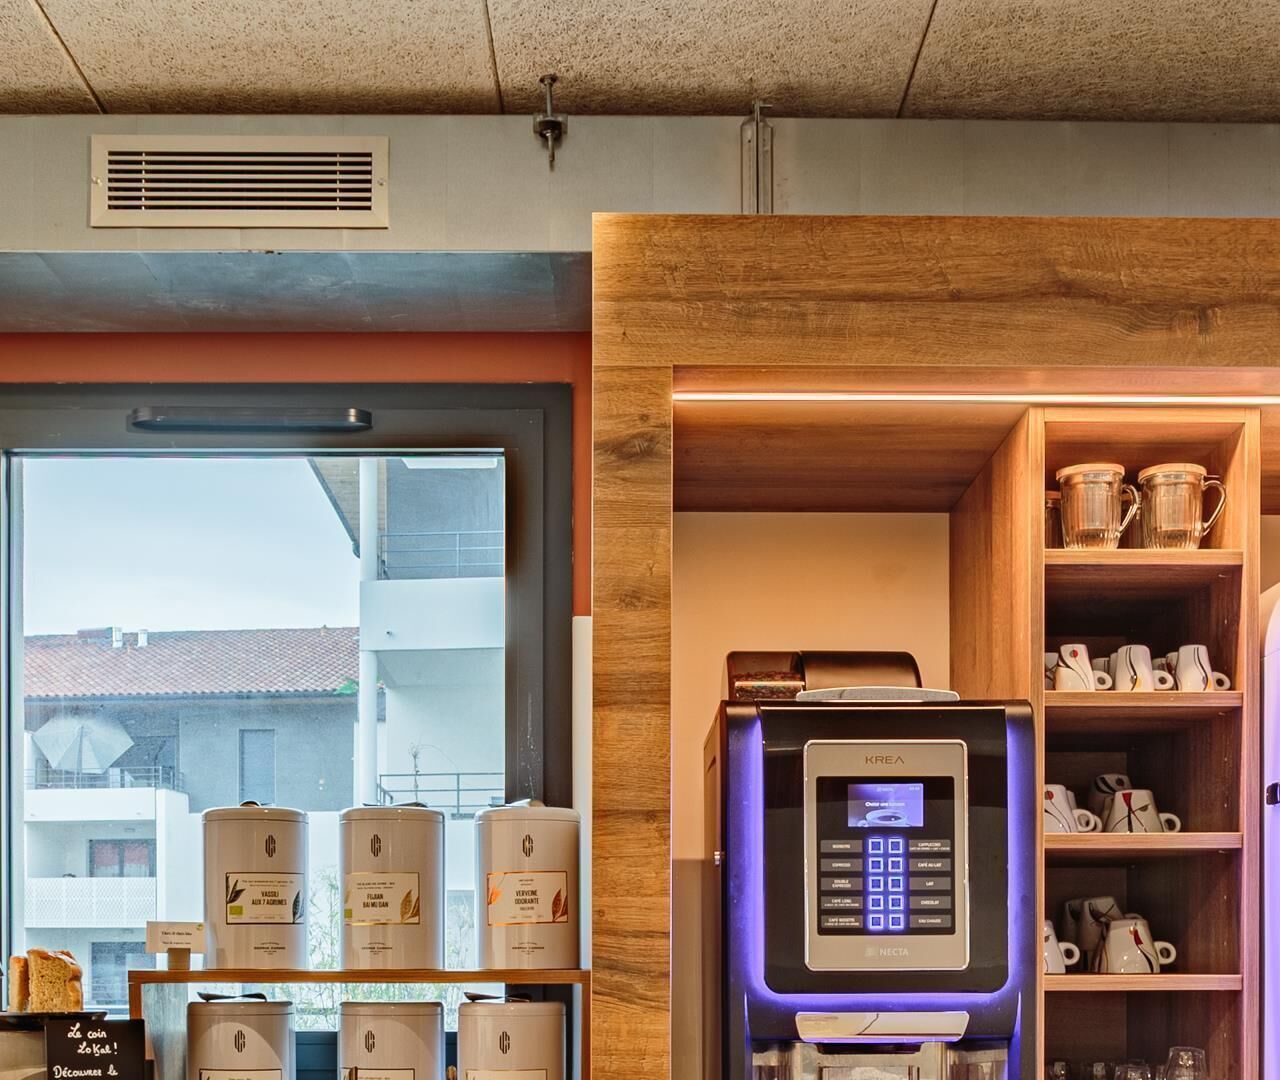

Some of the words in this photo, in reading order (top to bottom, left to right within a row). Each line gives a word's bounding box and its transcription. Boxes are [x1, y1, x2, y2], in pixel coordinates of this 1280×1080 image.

[865, 755, 905, 765] KREA
[879, 948, 909, 956] NECTA
[67, 1022, 82, 1039] Le
[87, 1029, 107, 1039] coin
[53, 1065, 102, 1078] Découvrez
[107, 1064, 118, 1076] le
